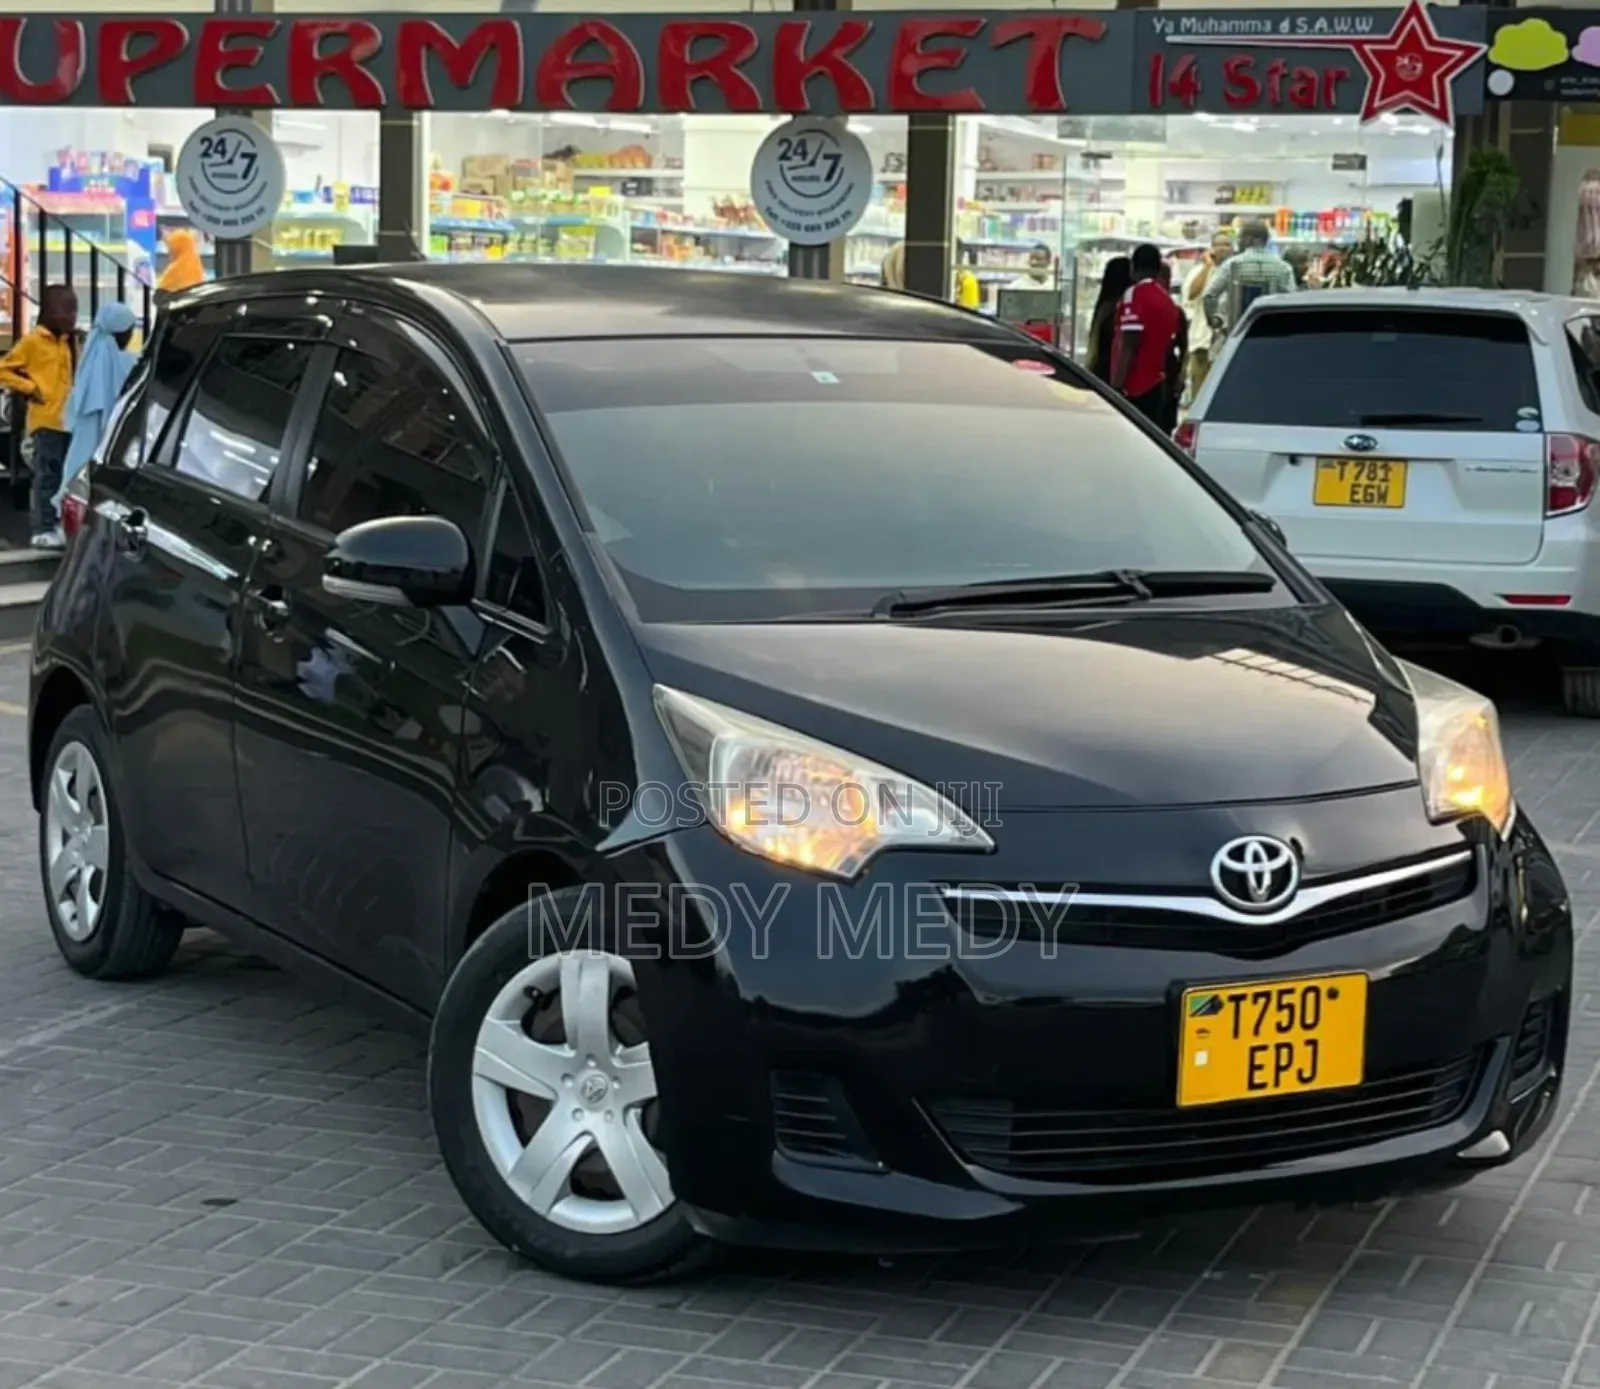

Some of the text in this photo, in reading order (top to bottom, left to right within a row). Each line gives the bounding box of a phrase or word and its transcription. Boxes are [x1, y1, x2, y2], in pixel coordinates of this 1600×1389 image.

[1152, 17, 1174, 33] Ya
[1296, 17, 1373, 33] S.A.W.W
[1149, 53, 1201, 108] 14
[1222, 54, 1350, 109] Star
[1350, 483, 1389, 504] EGW
[1227, 985, 1322, 1039] T750
[1247, 1038, 1319, 1090] EPJ
